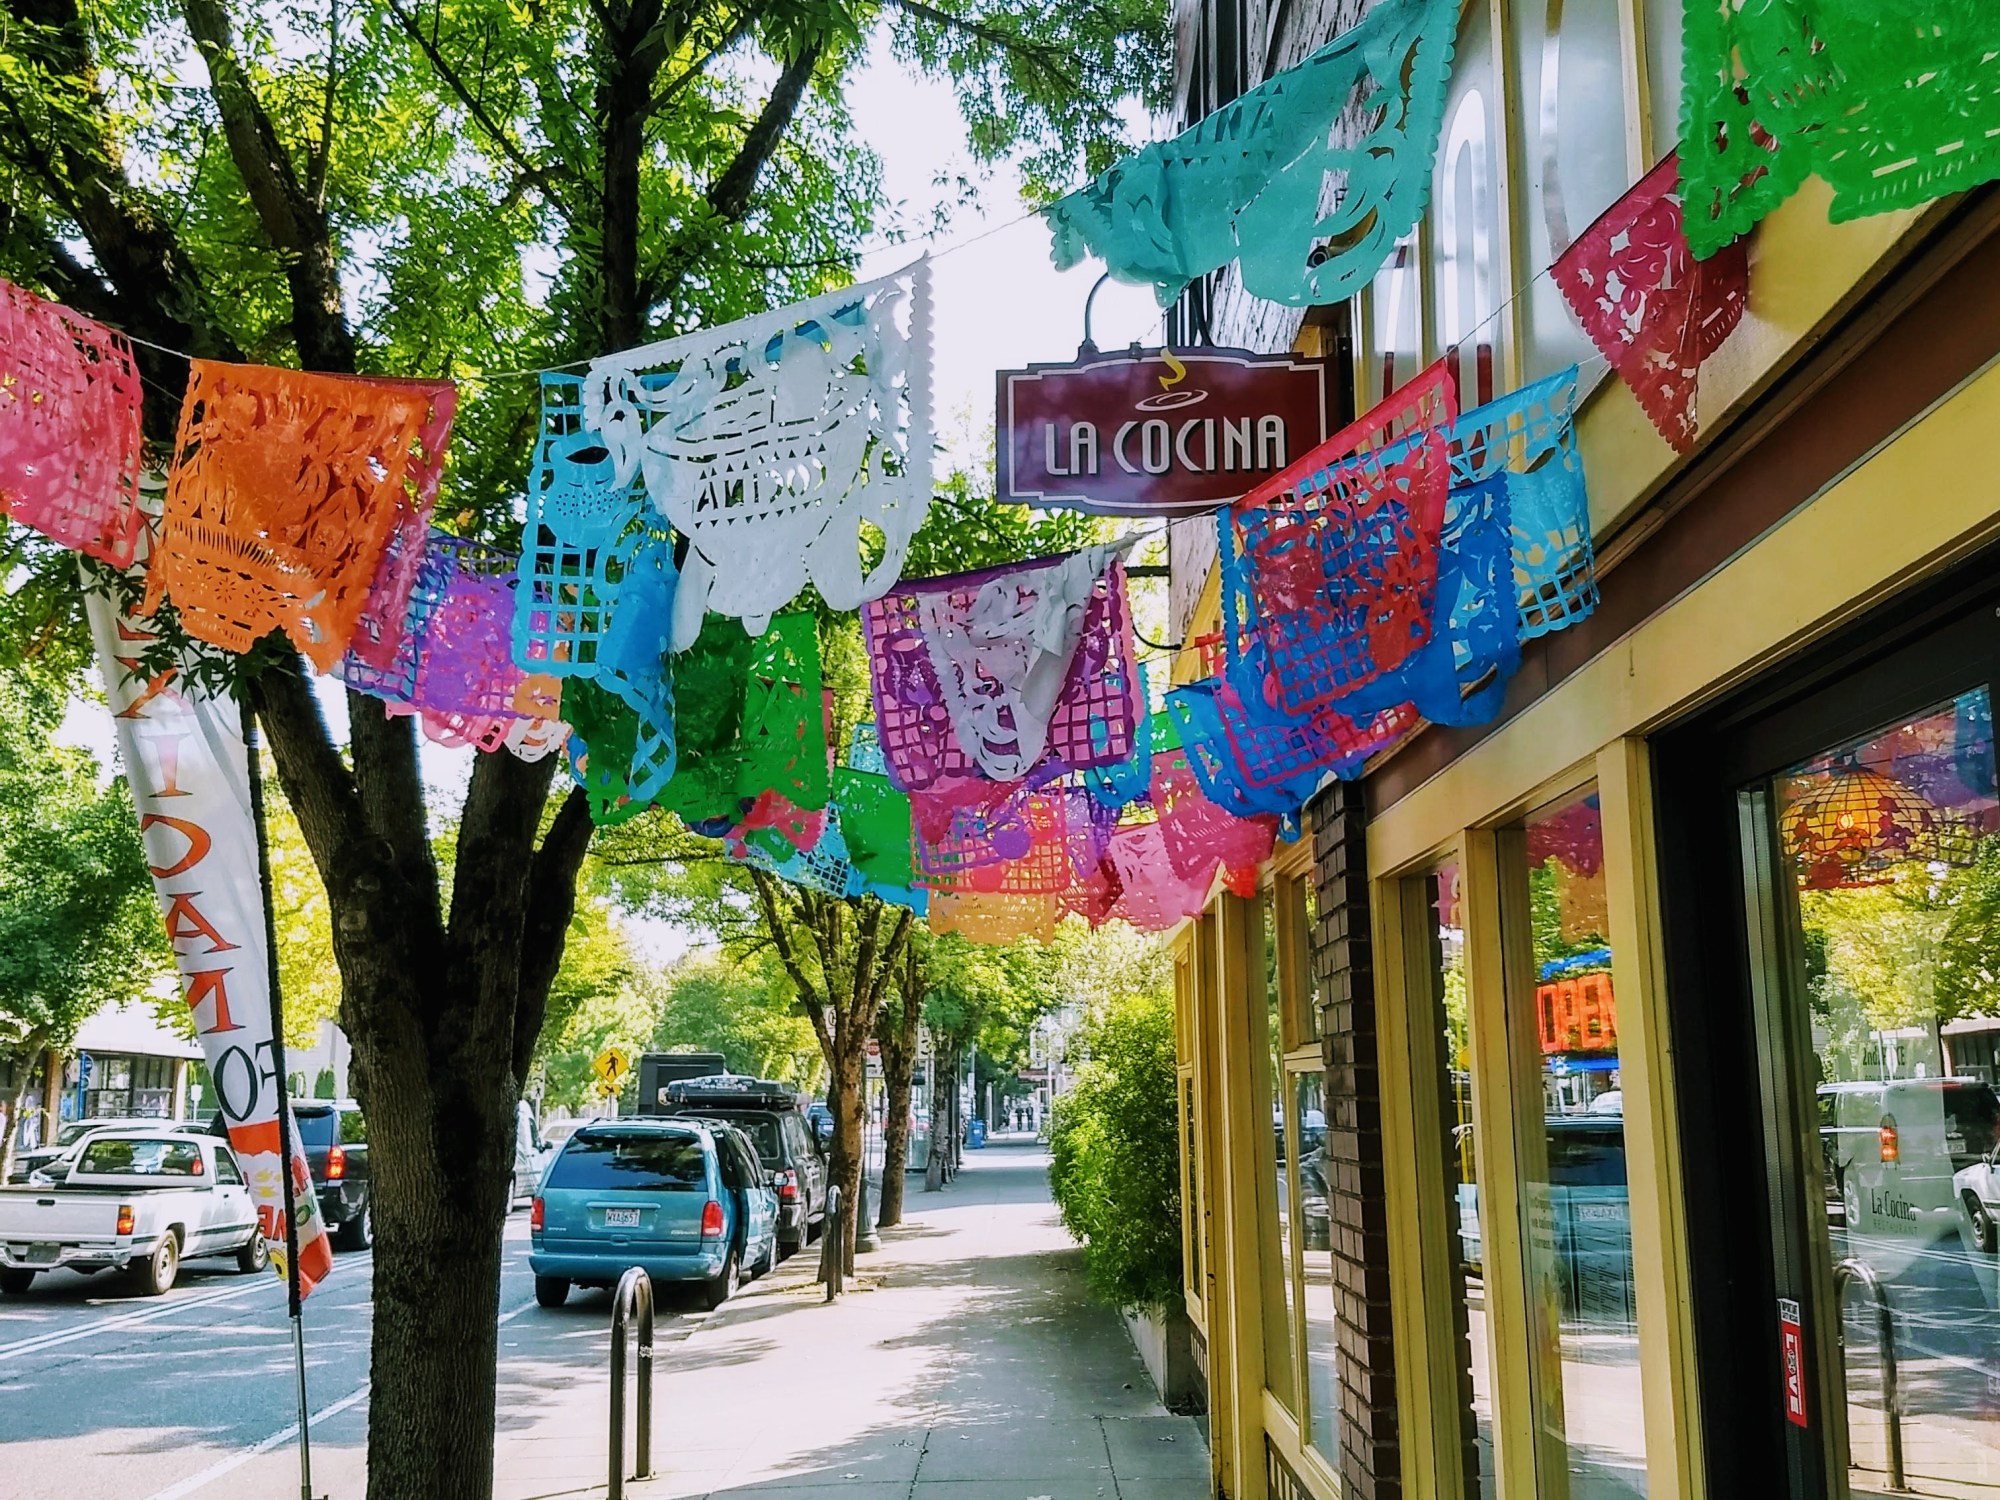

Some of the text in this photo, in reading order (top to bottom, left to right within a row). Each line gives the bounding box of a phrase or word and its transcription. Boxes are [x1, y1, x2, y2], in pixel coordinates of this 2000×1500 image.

[1045, 415, 1286, 475] LA COCINA
[1871, 1188, 1917, 1222] La Cocina
